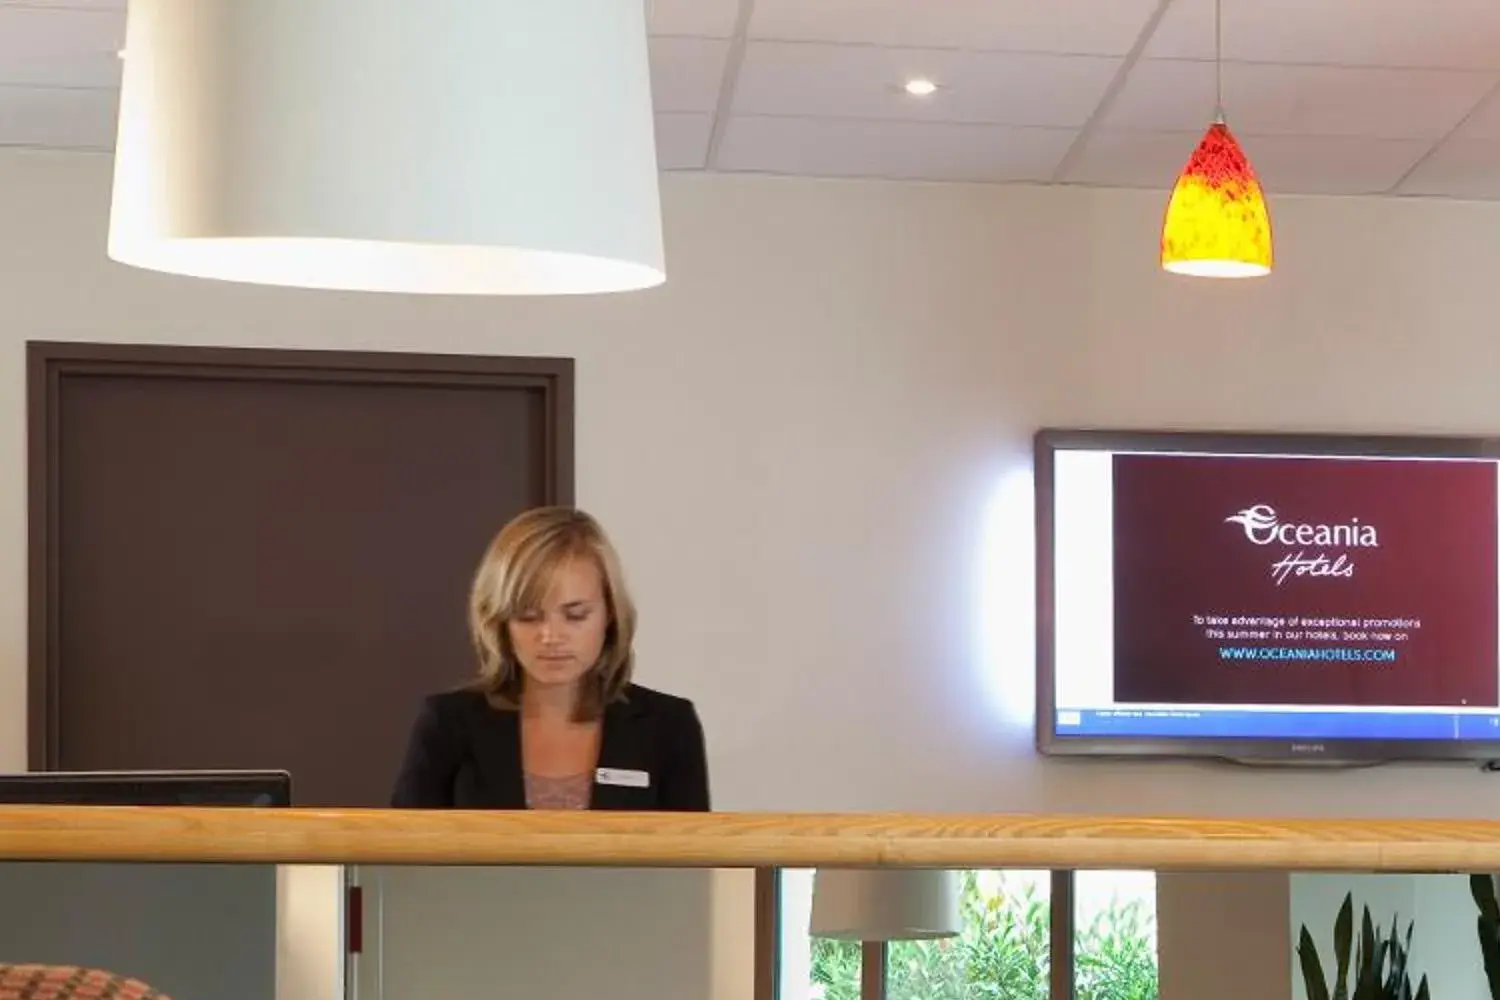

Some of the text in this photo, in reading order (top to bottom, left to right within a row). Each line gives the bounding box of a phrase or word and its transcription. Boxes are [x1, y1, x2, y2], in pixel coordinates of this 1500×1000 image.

[1225, 505, 1378, 547] Oceania
[1271, 551, 1355, 586] Hotels
[1193, 615, 1421, 629] To take advantage of exceptional promotions
[1206, 629, 1225, 639] this
[1227, 630, 1271, 639] summer
[1274, 630, 1283, 639] in
[1285, 631, 1303, 640] our
[1394, 633, 1409, 641] on
[1220, 647, 1396, 661] WWW.OCEANIAHOTELS.COM
